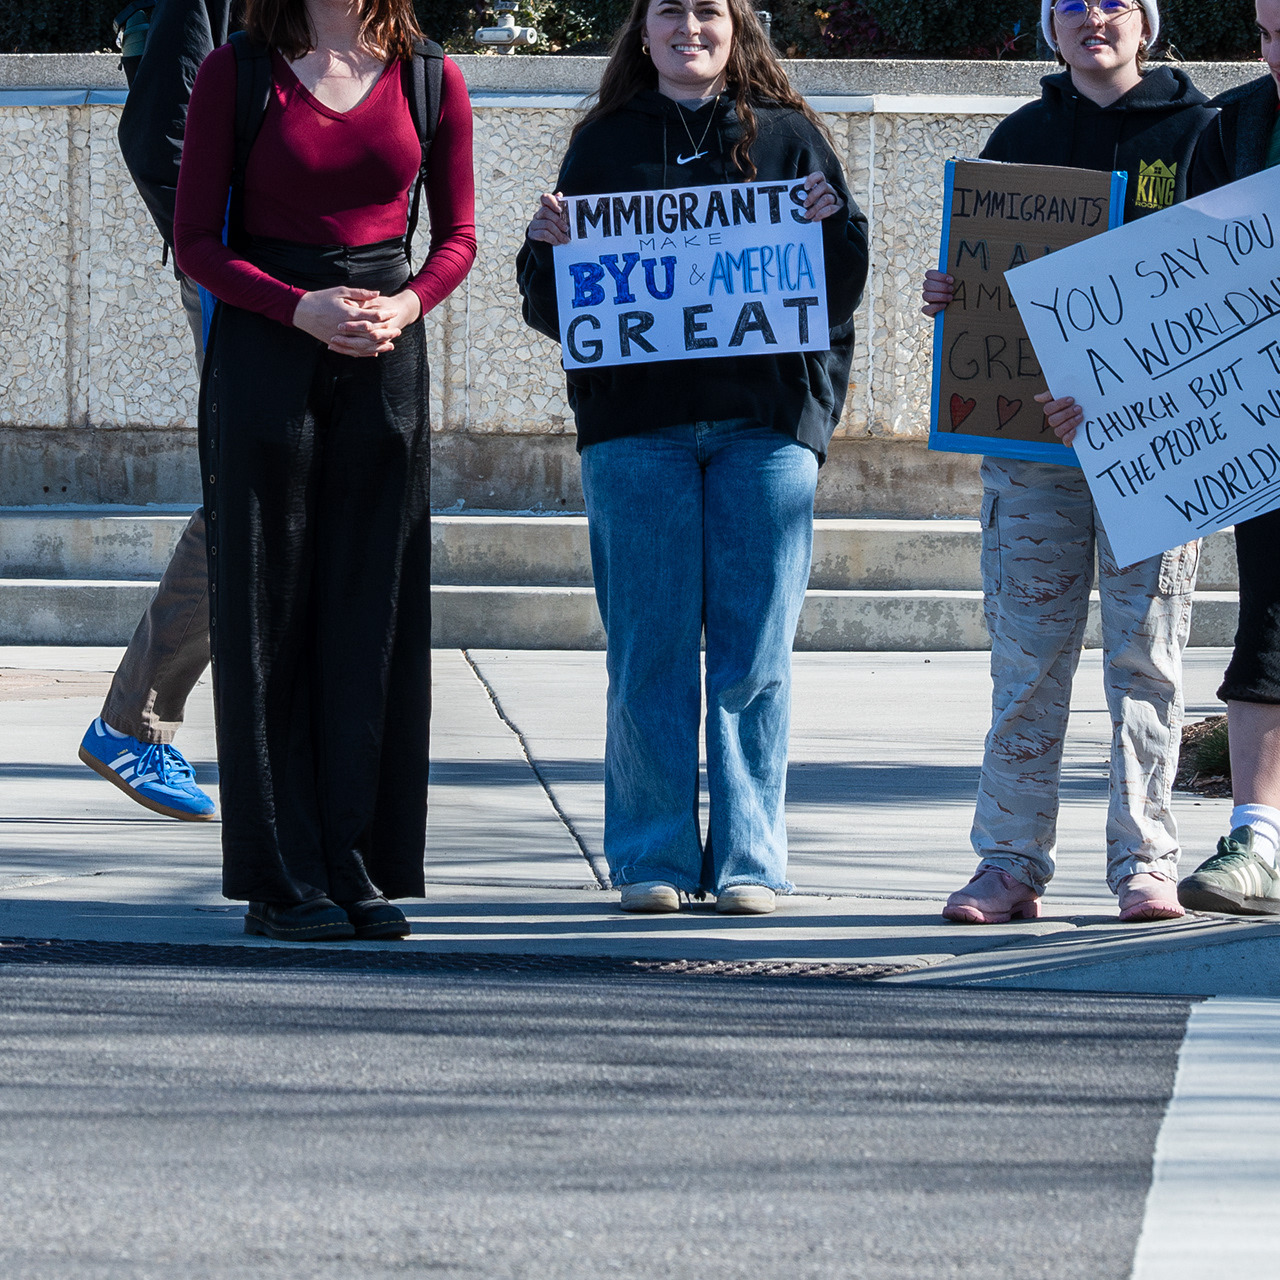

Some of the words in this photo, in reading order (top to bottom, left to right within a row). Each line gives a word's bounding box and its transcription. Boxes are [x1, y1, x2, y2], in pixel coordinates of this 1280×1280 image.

[952, 187, 1109, 227] IMMIGRANTS
[1136, 175, 1176, 206] KING
[639, 232, 723, 252] MAKE
[956, 238, 1054, 271] MA
[568, 251, 677, 308] BYU
[688, 263, 707, 286] &
[708, 242, 817, 296] AMERICA
[1031, 275, 1124, 342] YOU
[1134, 237, 1209, 299] SAY
[1207, 213, 1274, 266] YOU
[566, 296, 819, 364] GREAT
[948, 331, 1043, 380] GRE
[1086, 348, 1124, 396] A
[1085, 392, 1180, 452] CHURCH
[1188, 357, 1244, 410] BUT
[1096, 450, 1156, 499] THE
[1152, 411, 1228, 472] PEOPLE
